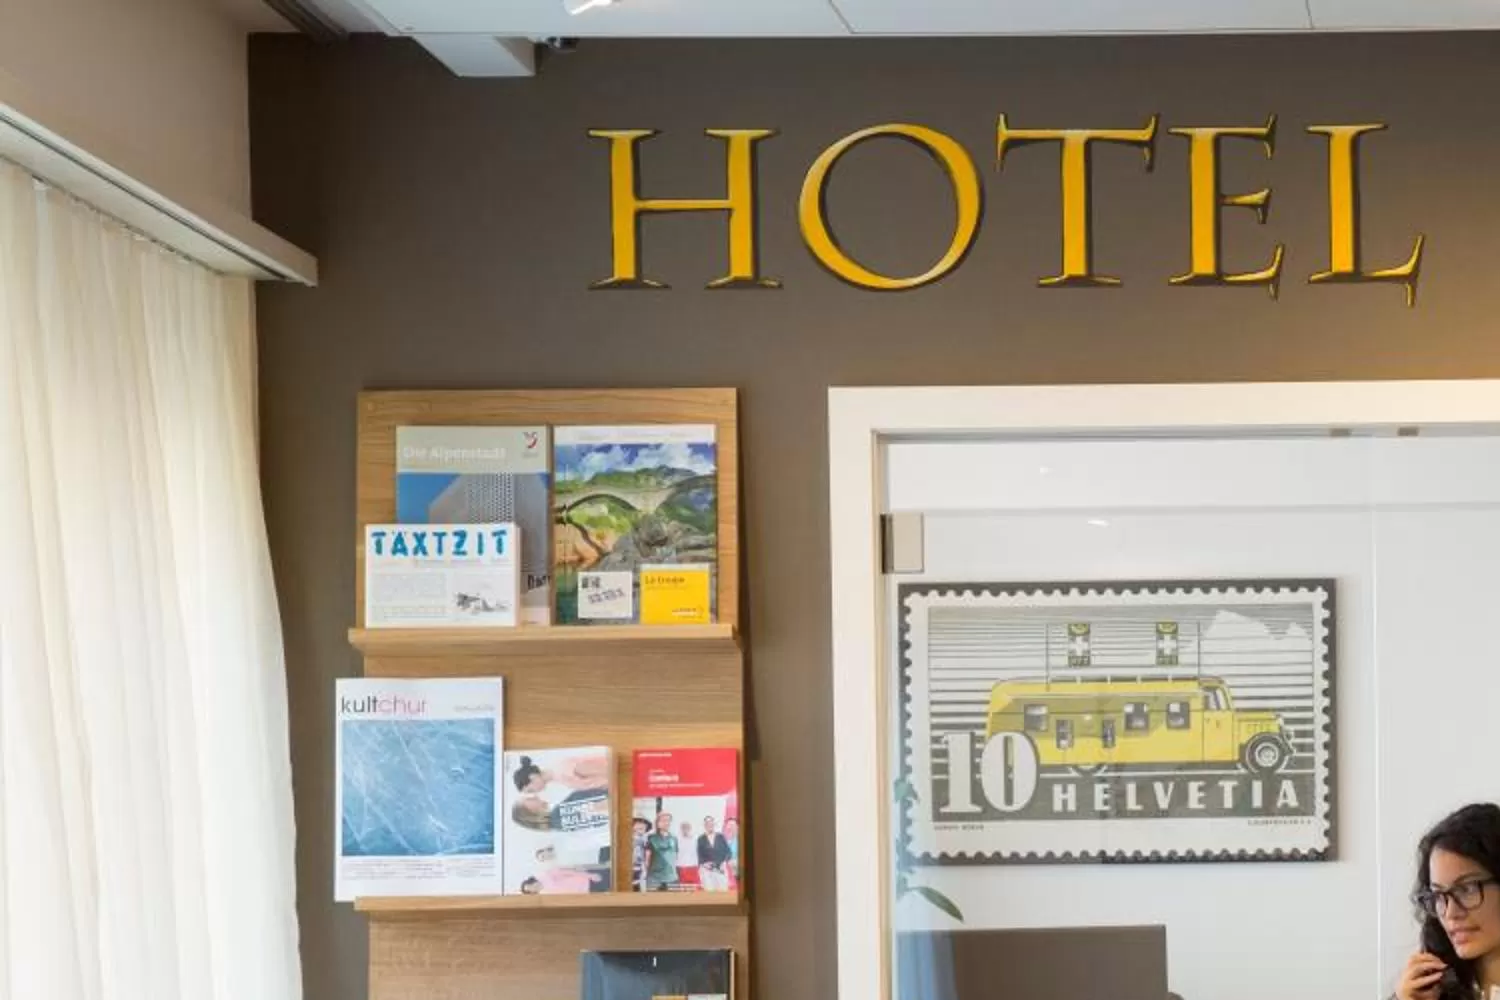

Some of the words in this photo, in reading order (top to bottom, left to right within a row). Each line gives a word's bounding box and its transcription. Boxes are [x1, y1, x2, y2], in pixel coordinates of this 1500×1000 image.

[587, 110, 1428, 306] HOTEL
[341, 695, 427, 713] kultchur
[939, 730, 1040, 814] 10
[1052, 779, 1300, 812] HELVETIA
